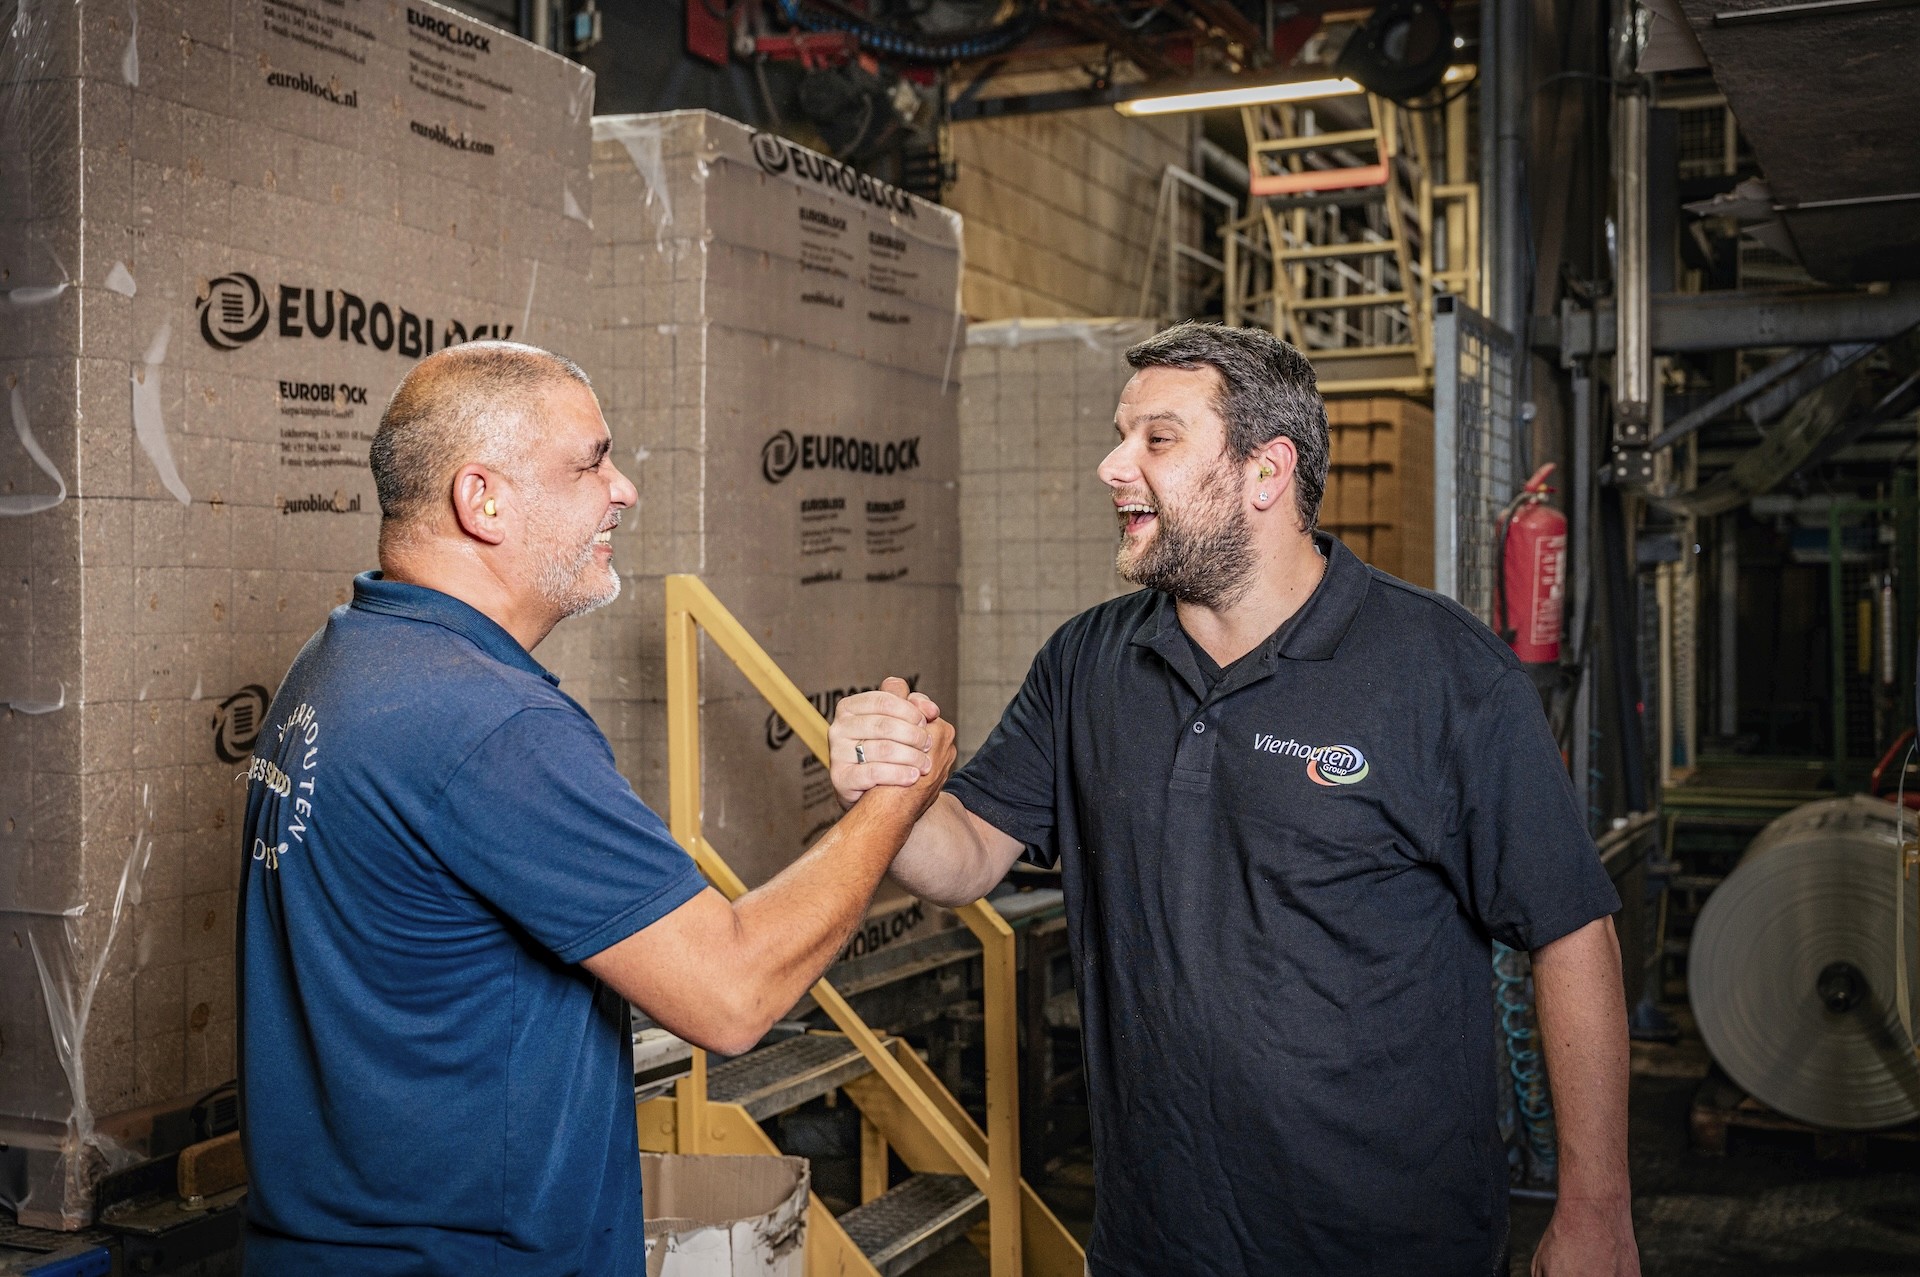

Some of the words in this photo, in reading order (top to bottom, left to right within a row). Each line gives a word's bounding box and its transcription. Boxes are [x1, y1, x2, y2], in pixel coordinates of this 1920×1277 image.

[802, 434, 921, 475] EUROBLOCK
[1254, 733, 1354, 769] Vierhouten
[1322, 763, 1348, 776] Group
